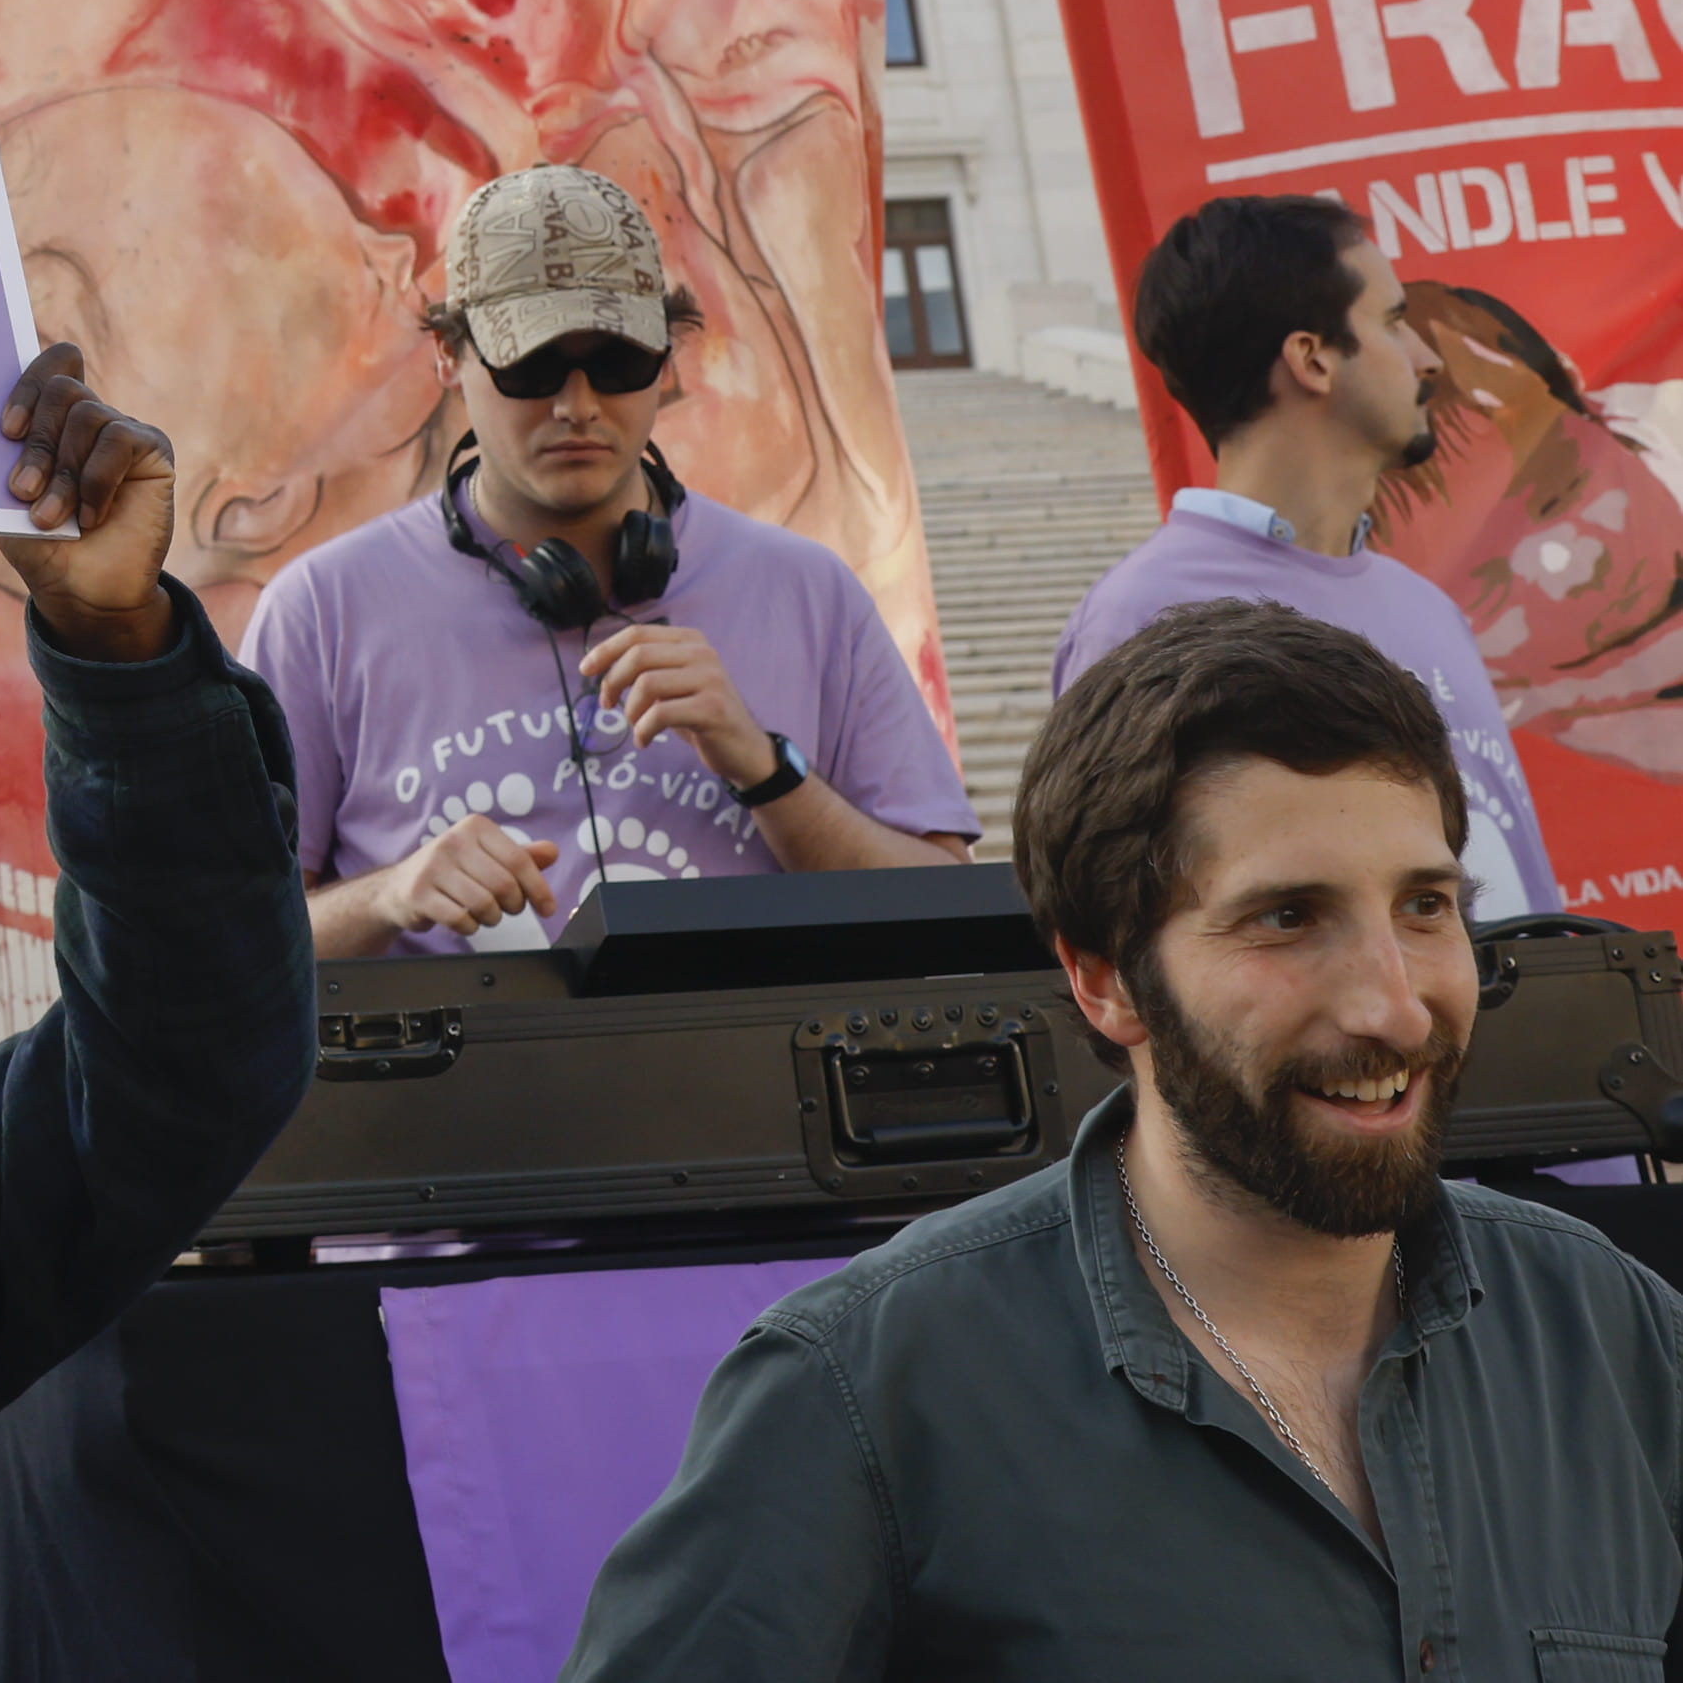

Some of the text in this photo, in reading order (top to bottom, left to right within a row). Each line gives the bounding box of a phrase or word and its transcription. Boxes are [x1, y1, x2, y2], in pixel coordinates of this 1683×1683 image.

[396, 705, 628, 803] O FUTURO
[1609, 865, 1683, 898] VIDA
